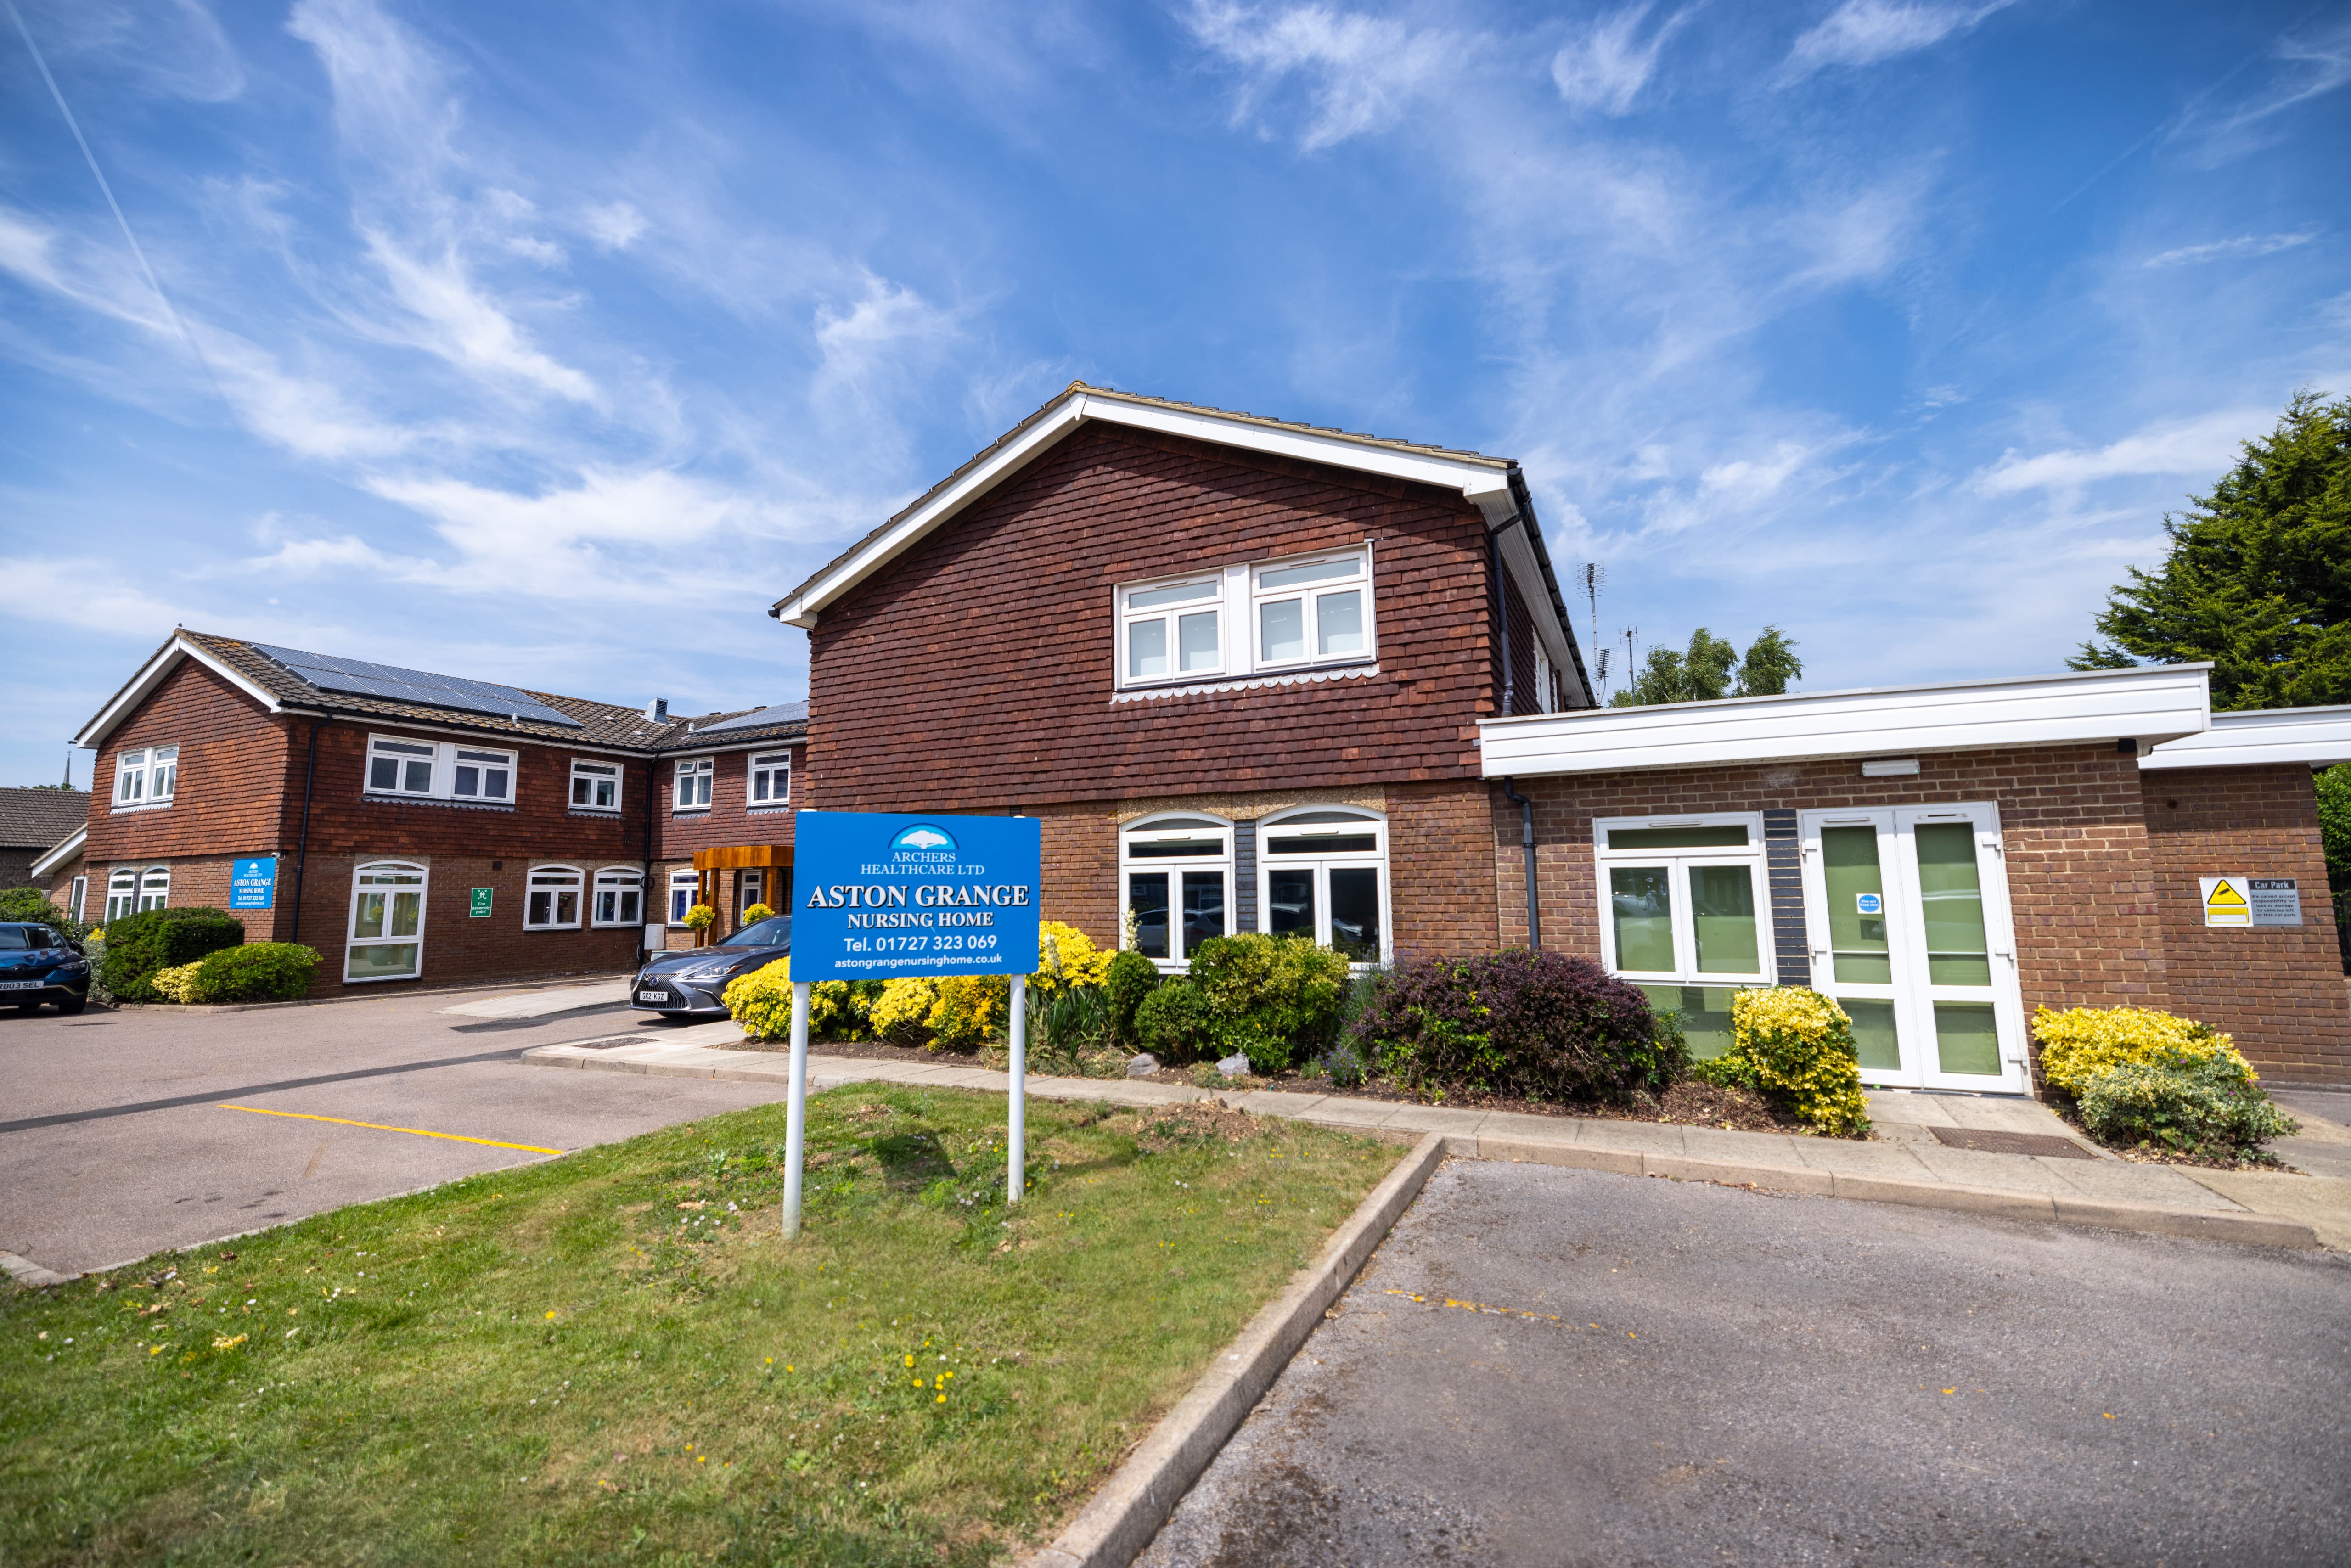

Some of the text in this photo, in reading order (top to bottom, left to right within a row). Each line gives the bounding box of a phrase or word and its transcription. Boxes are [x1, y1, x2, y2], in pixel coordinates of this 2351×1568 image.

[892, 852, 956, 863] ARCHERS
[860, 864, 985, 875] HEALTHCARE LTD
[250, 878, 272, 886] GRANGE
[806, 885, 1029, 908] ASTON GRANGE
[847, 912, 994, 929] NURSING HOME
[843, 935, 997, 952] Tel. 01727 323 069
[834, 953, 1002, 970] astongrangenursinghome.co.uk
